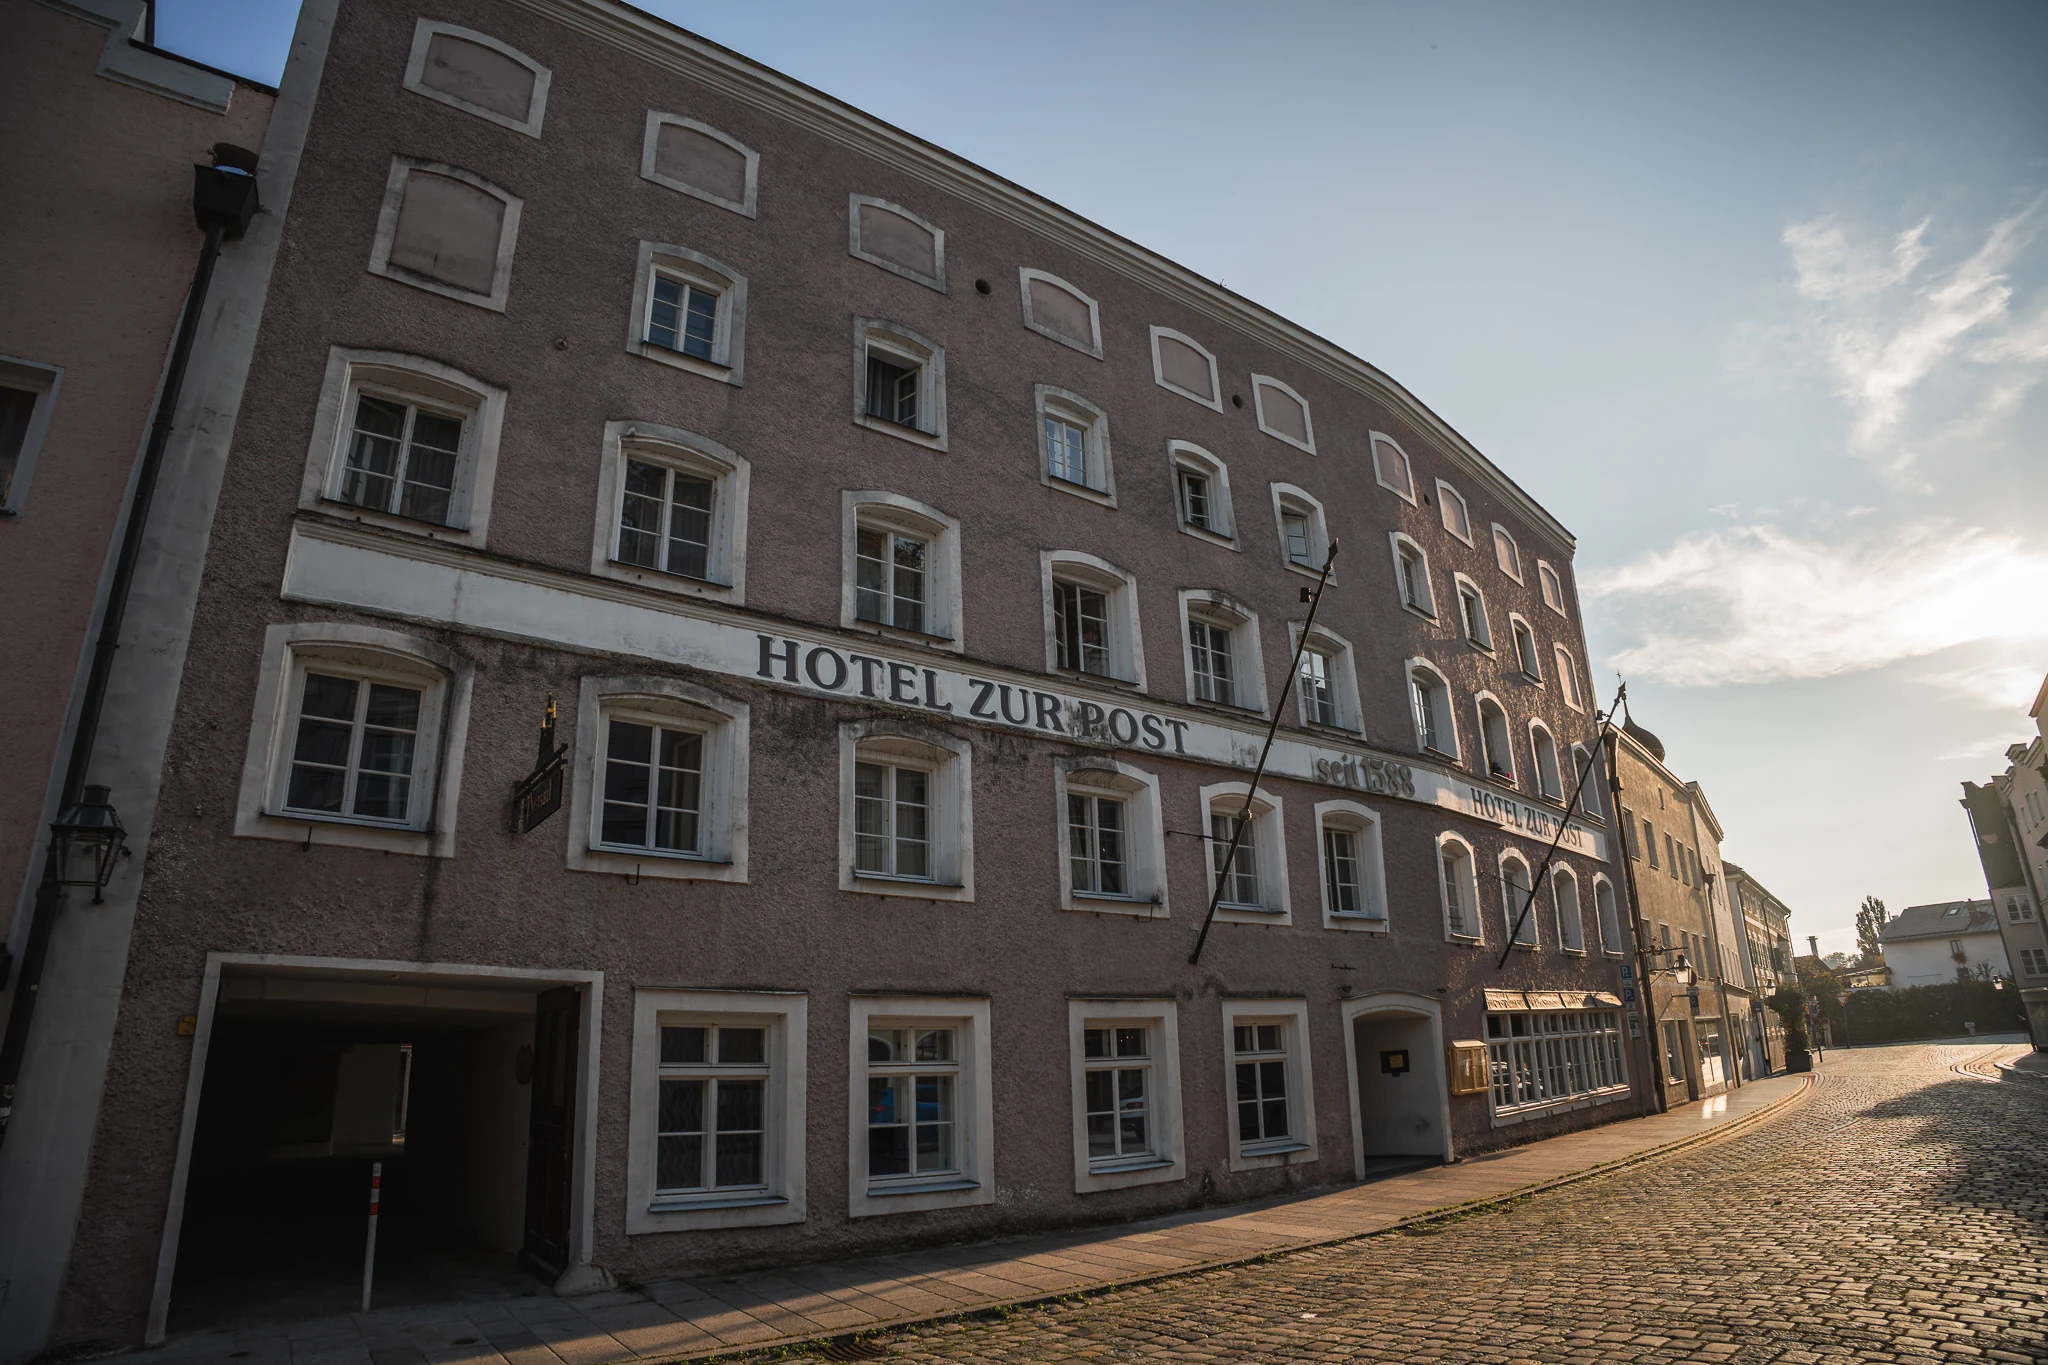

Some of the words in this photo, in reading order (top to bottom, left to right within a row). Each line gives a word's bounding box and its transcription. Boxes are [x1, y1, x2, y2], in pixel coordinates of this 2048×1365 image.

[756, 634, 953, 711] HOTEL
[968, 678, 1066, 732] ZUR
[1077, 700, 1190, 754] POST
[1317, 754, 1360, 785] seit
[1360, 756, 1416, 798] 1588
[1470, 787, 1522, 828] HOTEL
[1524, 806, 1552, 837] ZUR
[1552, 817, 1583, 848] POST
